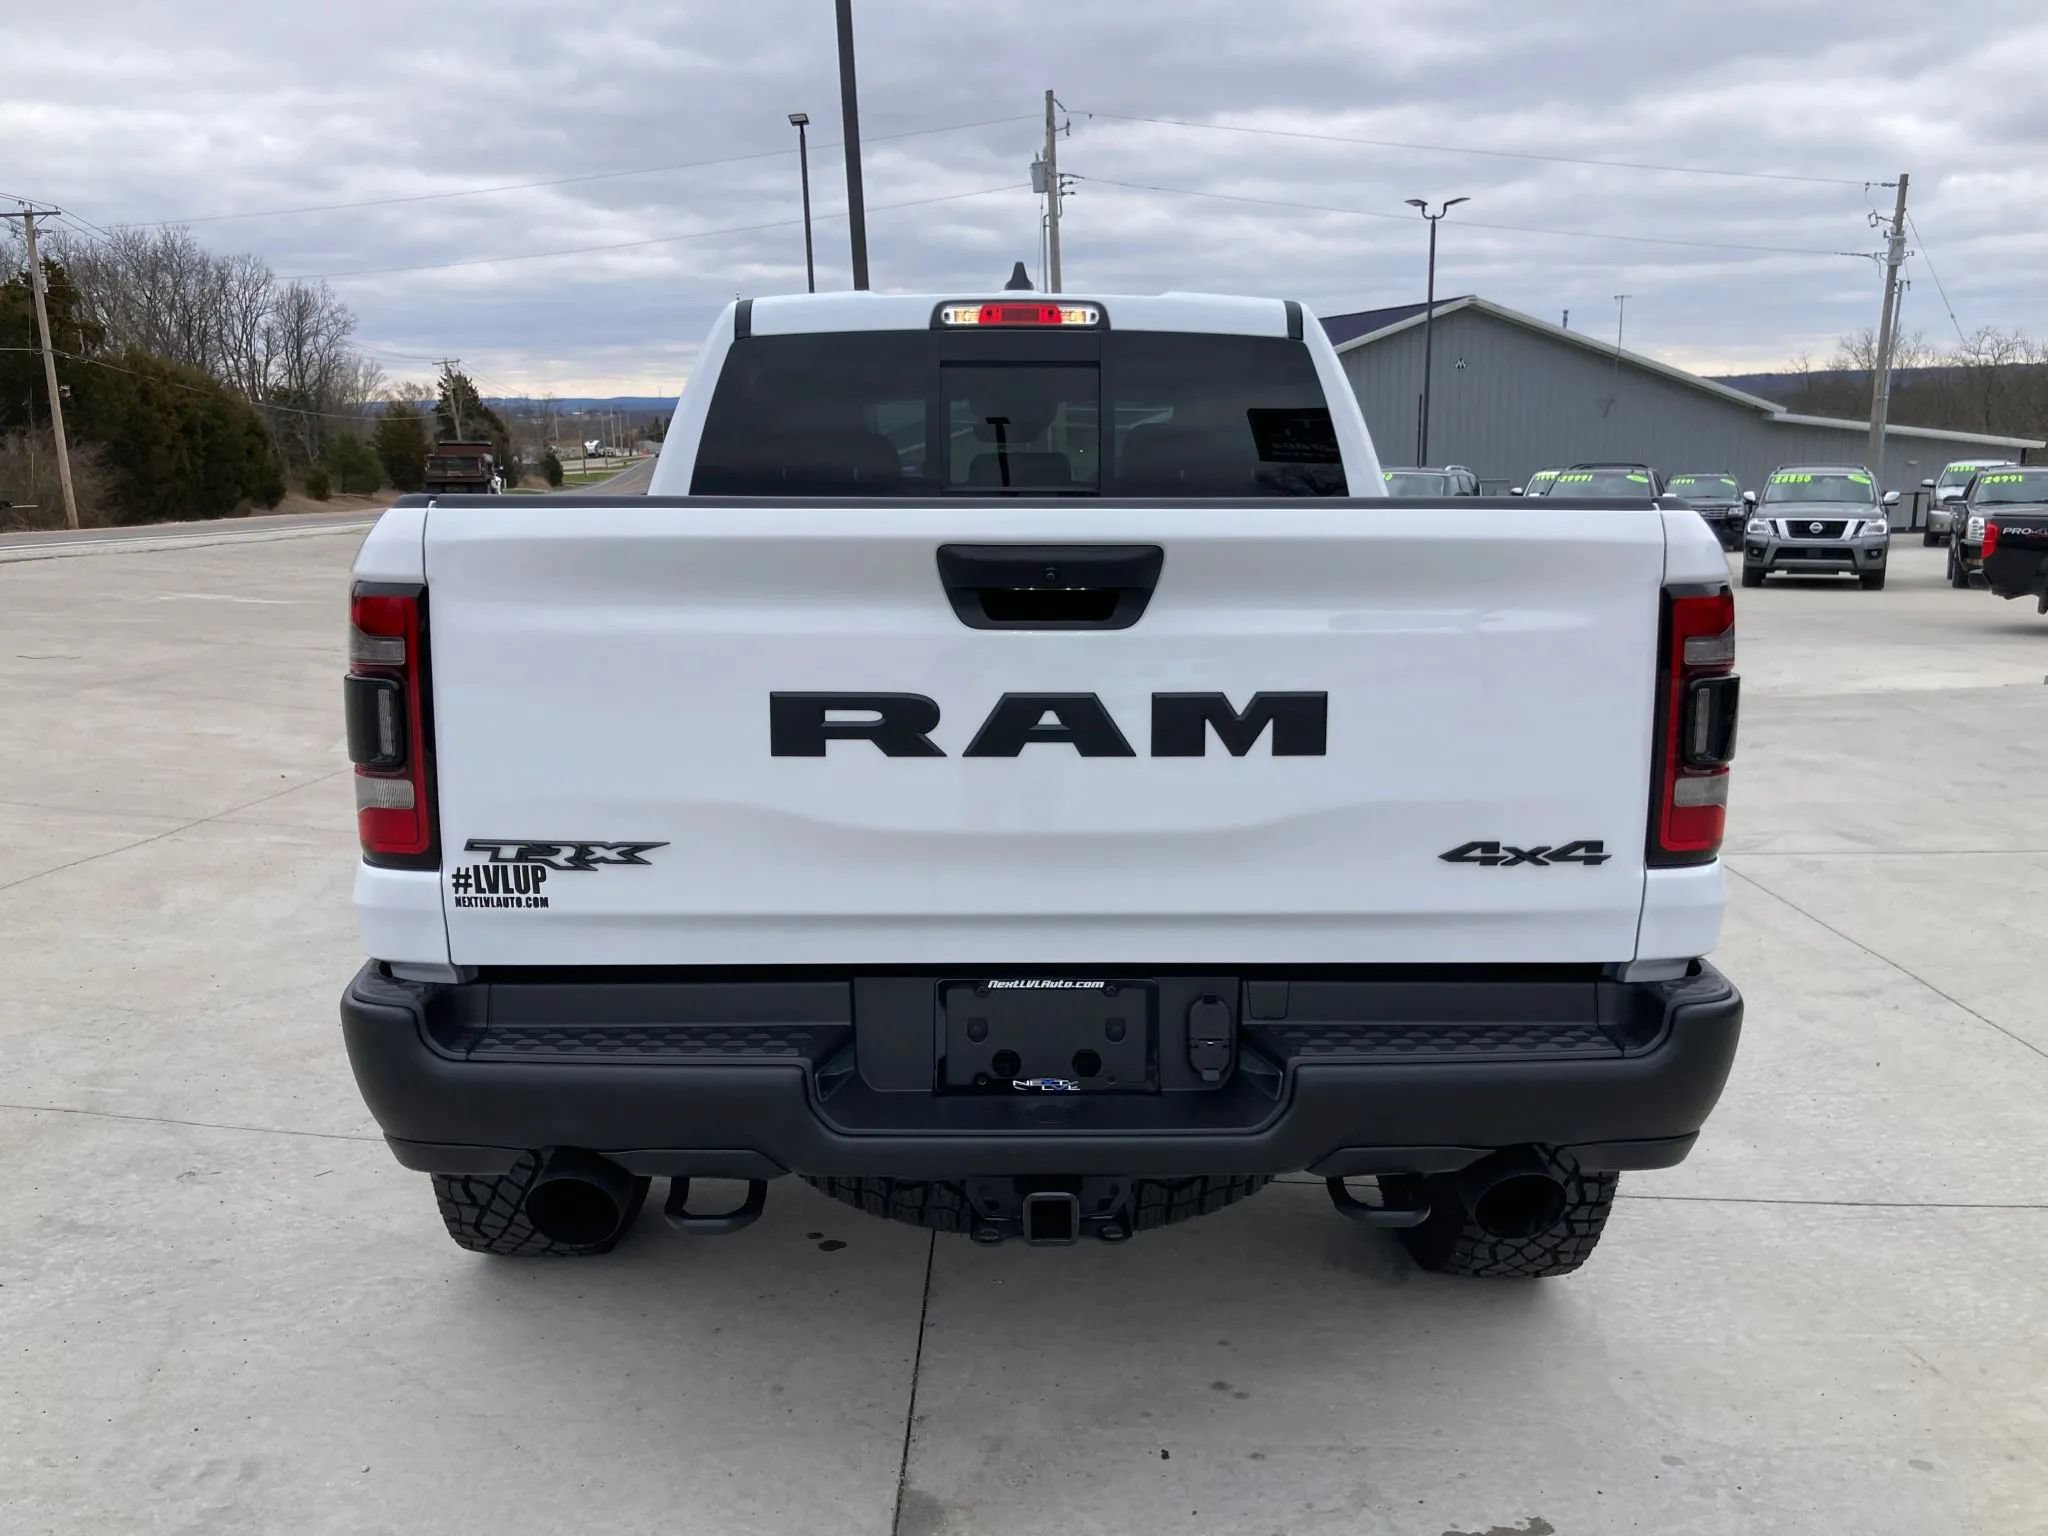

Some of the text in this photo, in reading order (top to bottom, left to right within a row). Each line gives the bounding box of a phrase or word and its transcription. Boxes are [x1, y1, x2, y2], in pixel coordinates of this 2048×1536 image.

[769, 690, 1328, 757] RAM
[464, 838, 670, 871] TRX
[452, 864, 547, 895] #LVLUP
[455, 896, 549, 908] NEXTLVLAUTO.COM
[987, 980, 1105, 989] NextLVLAuto.com
